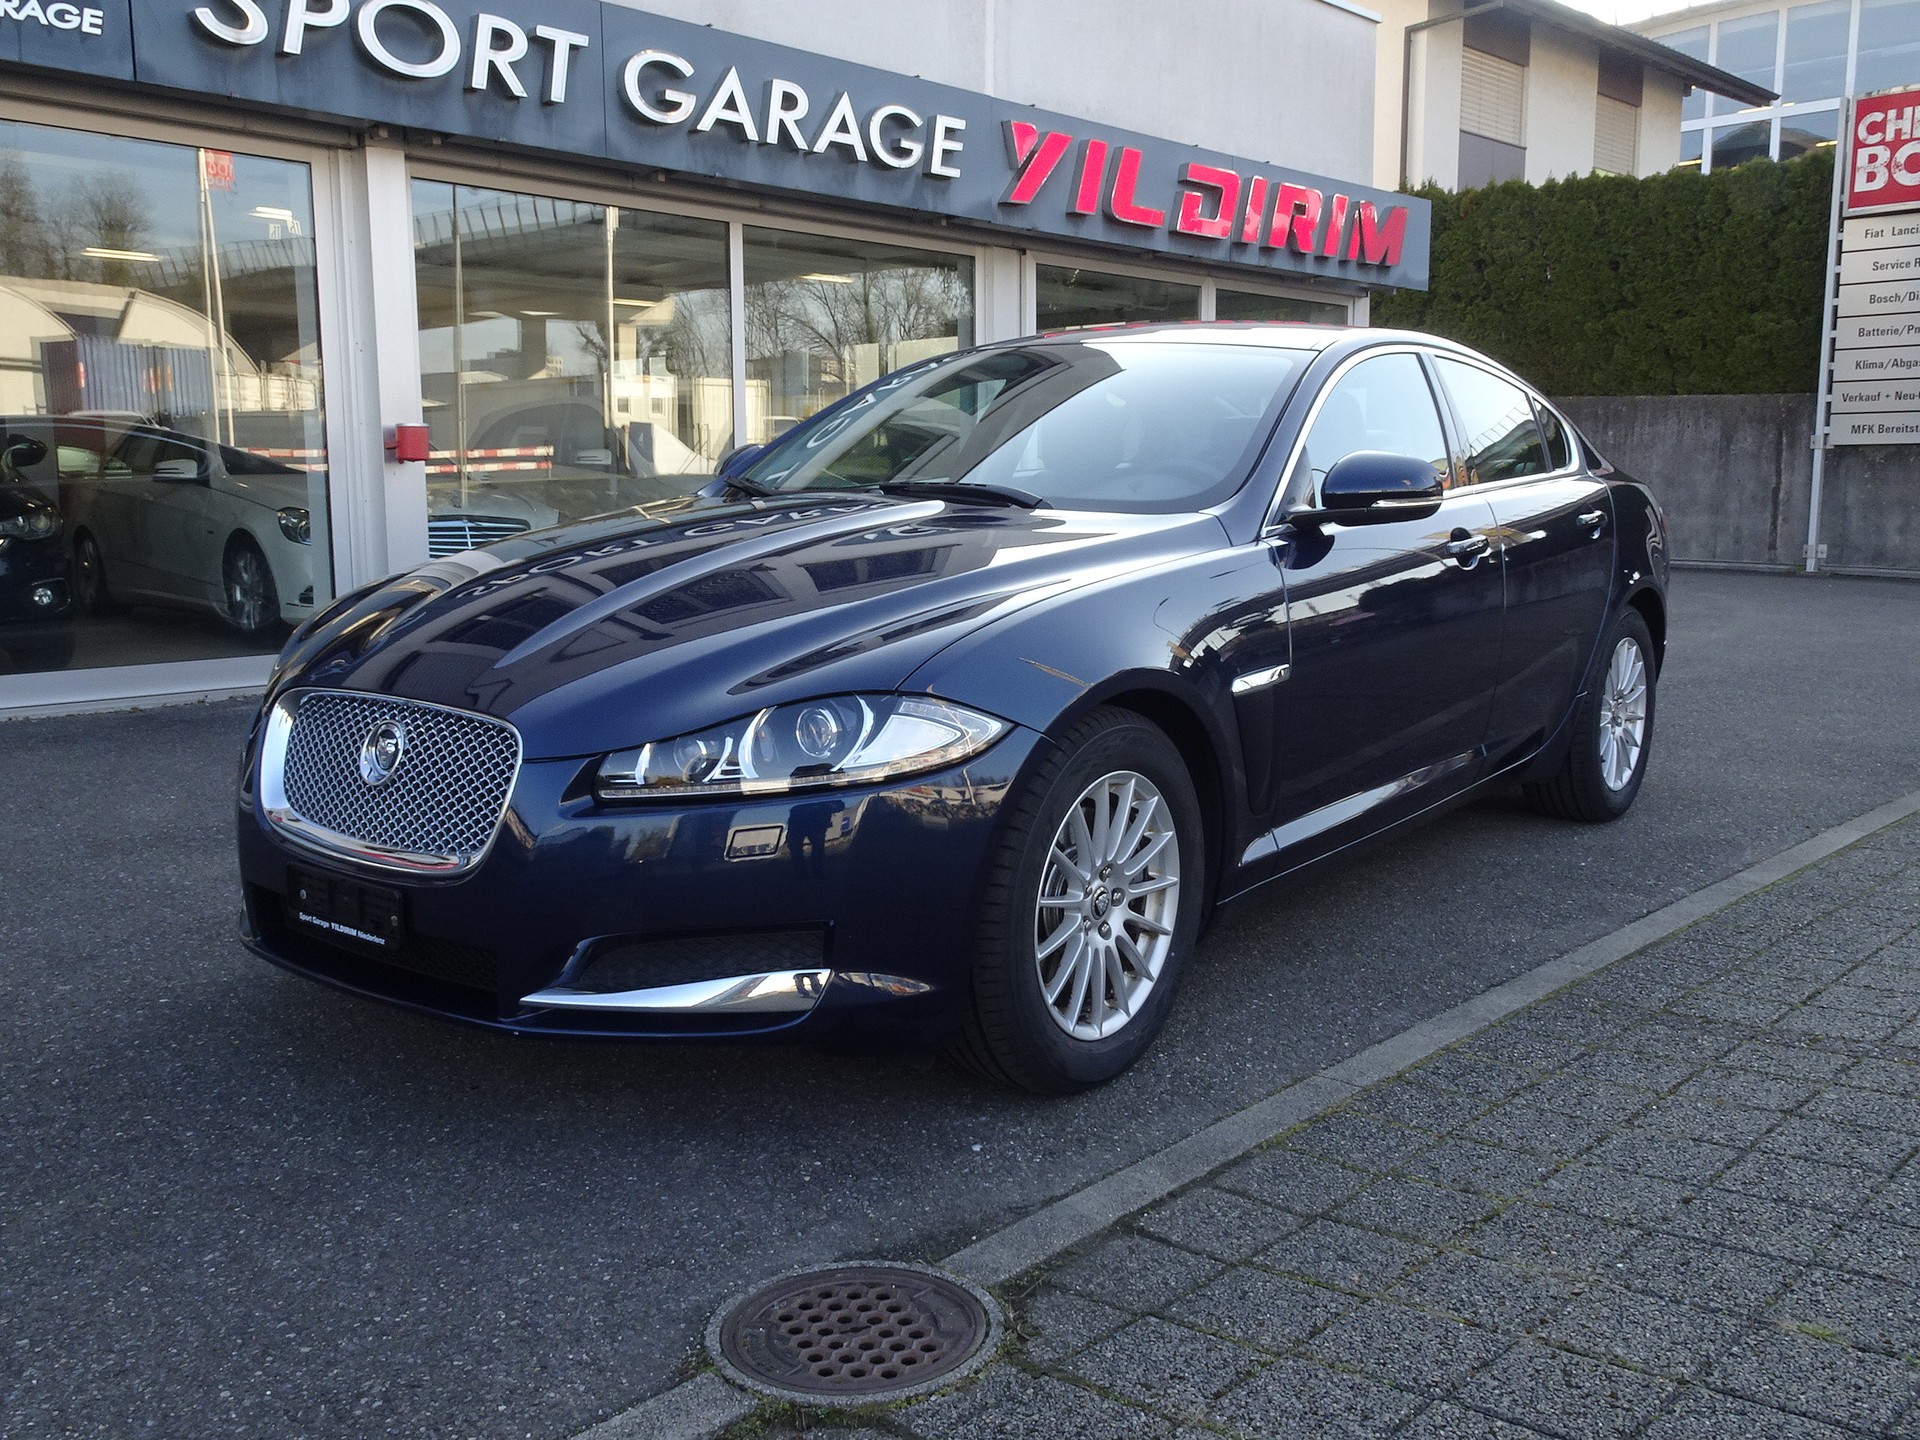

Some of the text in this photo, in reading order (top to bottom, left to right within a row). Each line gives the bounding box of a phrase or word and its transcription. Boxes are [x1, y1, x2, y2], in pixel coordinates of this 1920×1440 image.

[620, 49, 967, 178] GARAGE
[1001, 119, 1409, 267] YILDIRIM
[1864, 223, 1920, 239] Fiat Lanci
[1872, 259, 1911, 272] Service
[1868, 290, 1920, 304] Bosch/Di
[1842, 391, 1881, 403] Verkauf
[1894, 390, 1920, 401] Neu-
[1850, 423, 1920, 435] MFK Bereitst
